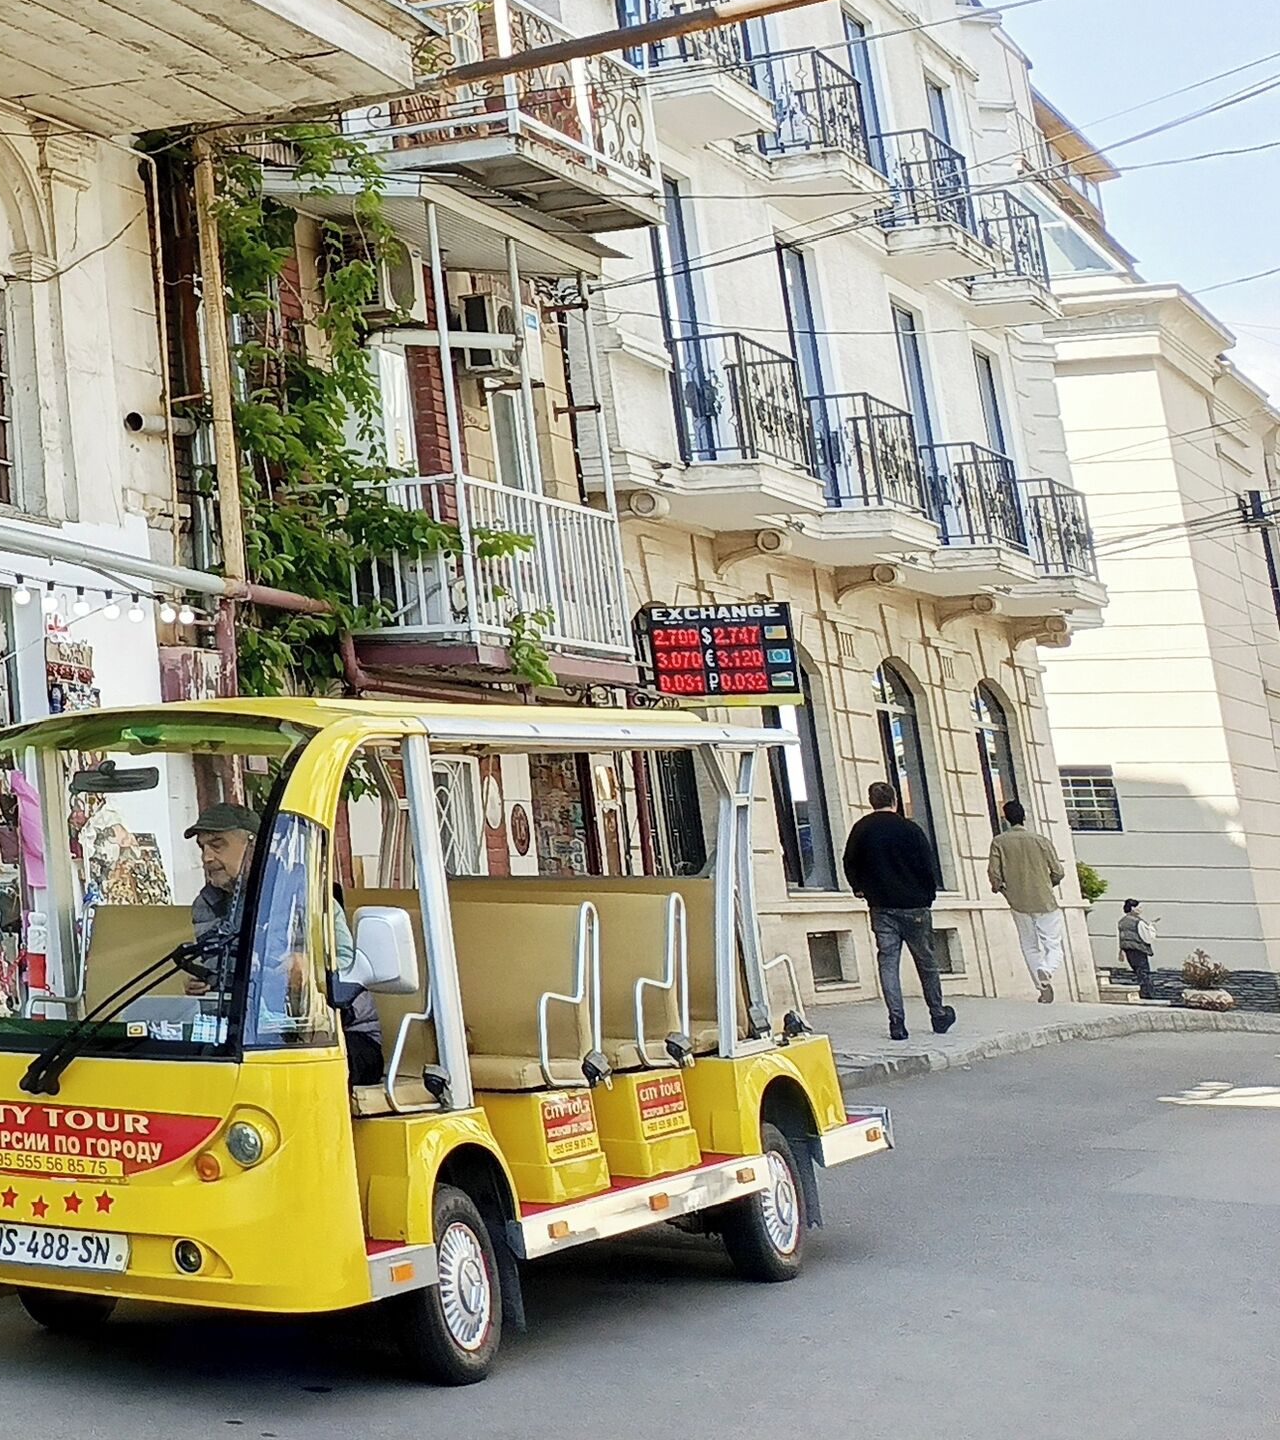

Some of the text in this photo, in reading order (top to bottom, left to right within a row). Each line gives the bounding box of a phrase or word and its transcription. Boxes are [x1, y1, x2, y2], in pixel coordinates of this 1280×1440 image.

[651, 603, 781, 621] EXCHANGE
[656, 651, 702, 669] 3.070
[716, 649, 763, 667] 3.120
[42, 1107, 150, 1135] TOUR
[54, 1135, 81, 1155] ПО
[85, 1137, 162, 1163] ГОРОДУ
[16, 1154, 42, 1170] 555
[46, 1156, 63, 1172] 56
[67, 1158, 85, 1173] 85
[89, 1159, 108, 1175] 75
